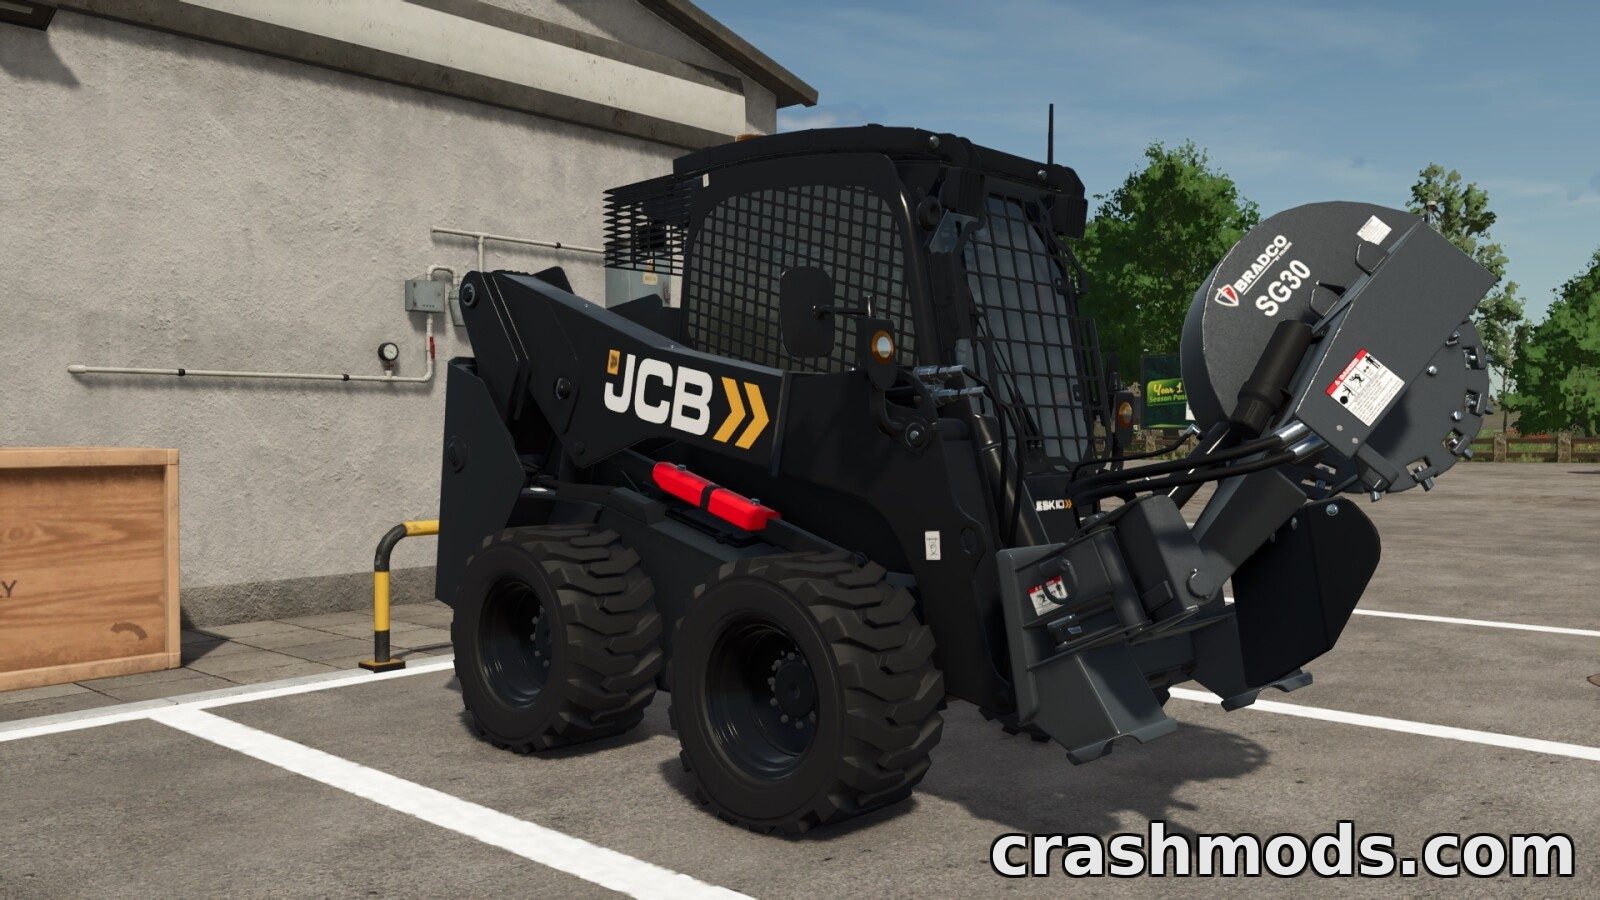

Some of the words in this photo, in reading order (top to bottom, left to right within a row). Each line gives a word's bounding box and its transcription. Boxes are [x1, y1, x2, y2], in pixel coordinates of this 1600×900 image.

[1233, 235, 1287, 293] BRADCO
[1255, 260, 1311, 317] SG30
[604, 353, 713, 436] JCB
[1153, 384, 1175, 396] Year
[1176, 382, 1184, 394] 1
